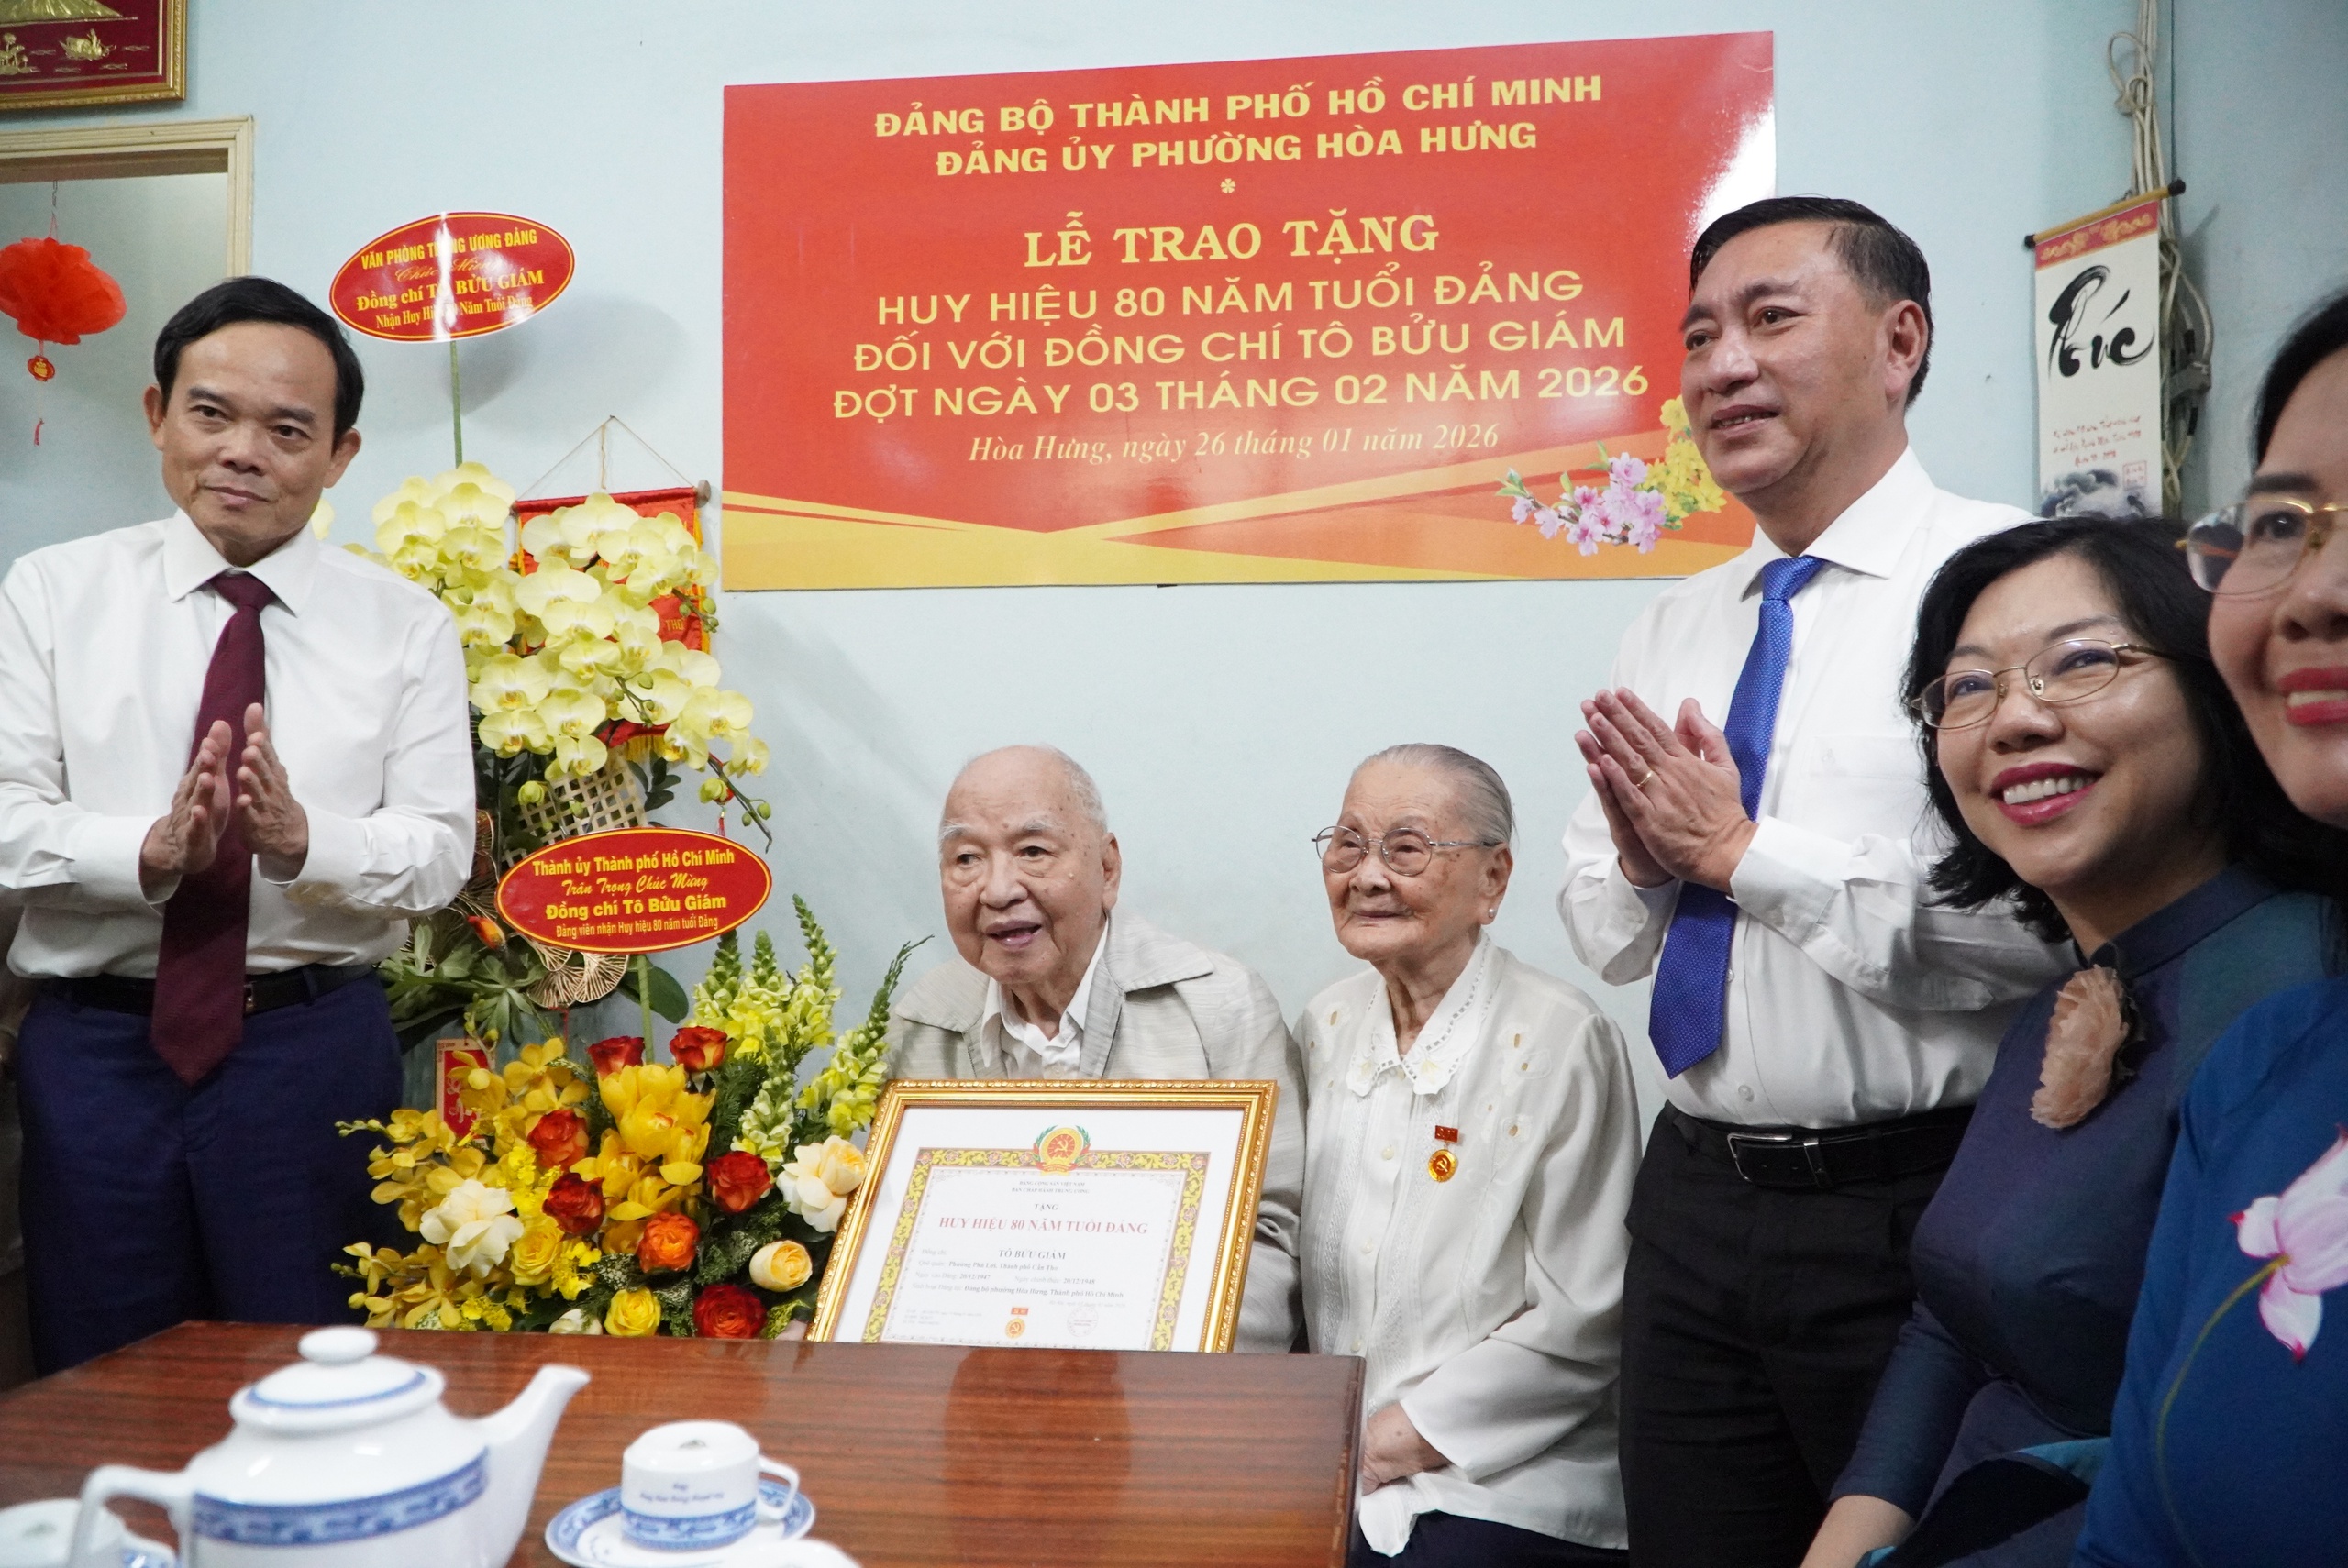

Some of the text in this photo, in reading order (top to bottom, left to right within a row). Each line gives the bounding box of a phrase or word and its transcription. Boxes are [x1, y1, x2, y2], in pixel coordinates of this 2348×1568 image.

[874, 74, 1601, 138] ĐẢNG BỘ THÀNH PHỐ HỒ CHÍ MINH
[936, 119, 1536, 176] ĐẢNG ỦY PHƯỜNG HÒA HƯNG
[361, 226, 537, 270] VĂN PHÒNG TNG ƯƠNG ĐẢNG
[1024, 207, 1439, 268] LỄ TRAO TẶNG
[356, 290, 398, 311] Đồng
[401, 285, 423, 304] chí
[497, 267, 545, 290] GIÁM
[878, 260, 1584, 325] HUY HIỆU 80 NĂM TUỔI ĐẢNG
[375, 313, 401, 330] Nhận
[403, 310, 421, 326] Huy
[460, 299, 483, 315] Năm
[853, 309, 1624, 372] ĐỐI VỚI ĐỒNG CHÍ TÔ BỬU GIÁM
[833, 363, 1650, 424] ĐỢT NGÀY 03 THÁNG 02 NĂM 2026
[968, 423, 1499, 465] Hòa Hưng, ngày 26 tháng 01 năm 2026
[533, 848, 735, 876] Thành ủy Thành phố Hồ Chí Minh
[561, 872, 708, 897] Trân Trọng Chúc Mừng
[546, 894, 727, 921] Đồng chí Tô Bửu Giám
[556, 913, 718, 940] Đảng viên nhận Huy hiệu 80 năm tuổi Đảng
